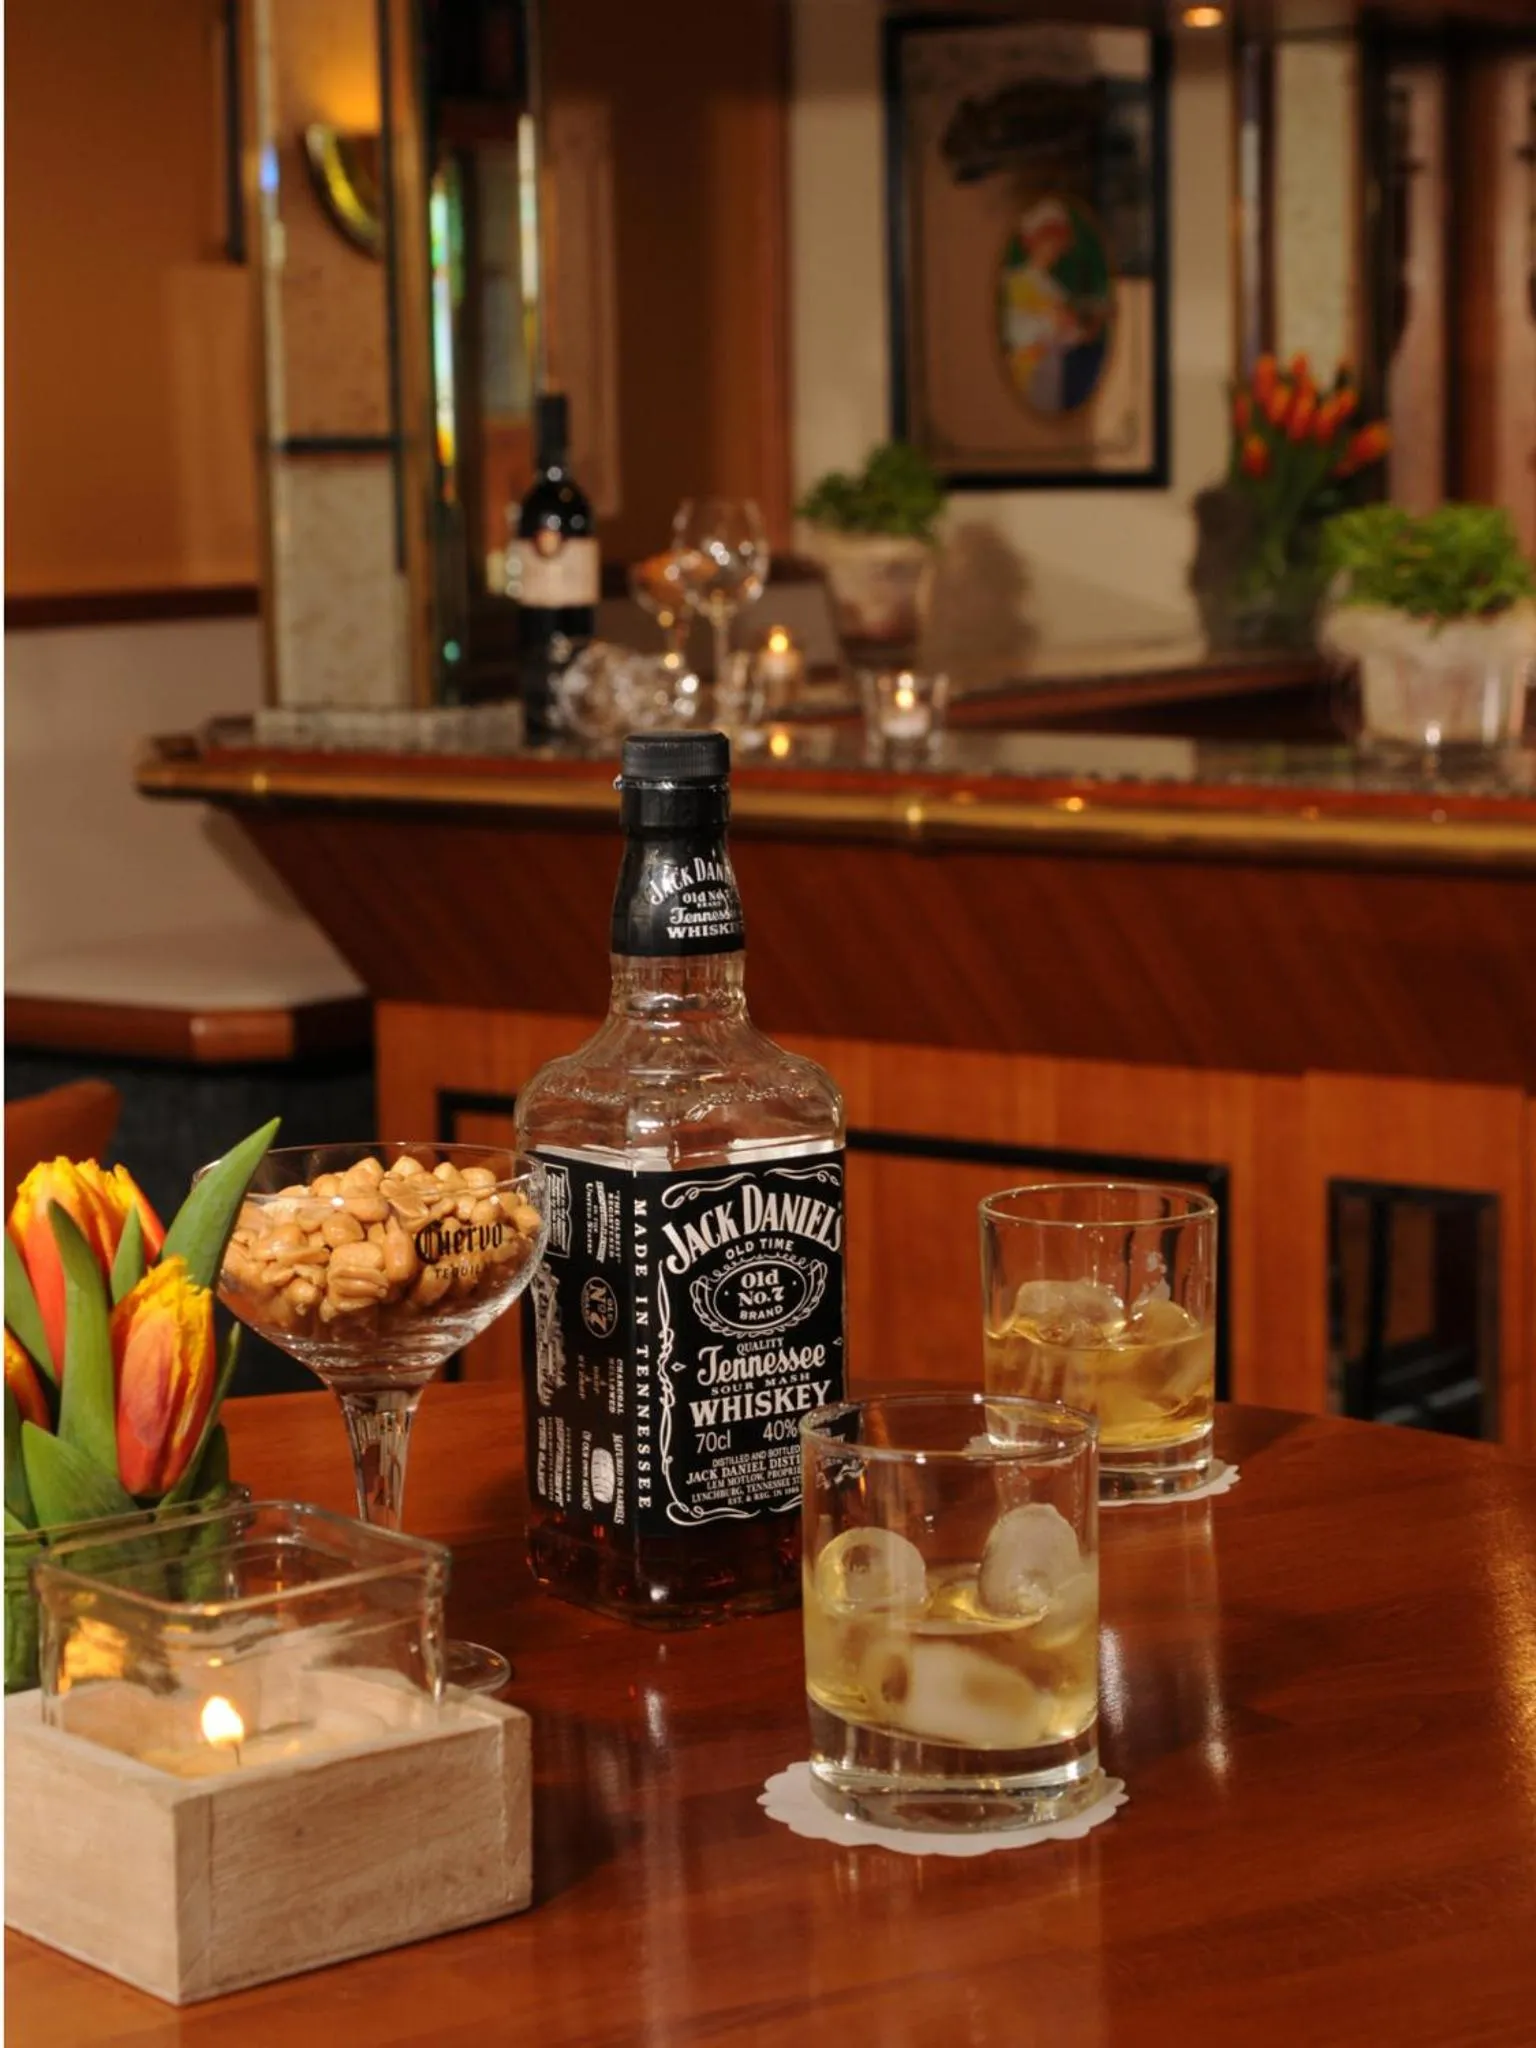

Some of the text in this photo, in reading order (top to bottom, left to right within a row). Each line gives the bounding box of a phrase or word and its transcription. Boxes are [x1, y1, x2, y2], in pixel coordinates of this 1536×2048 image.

[415, 1220, 502, 1264] Cuervo
[662, 1201, 741, 1274] JACK
[725, 1237, 794, 1260] OLD TIME
[738, 1268, 785, 1308] Old No.7
[740, 1305, 783, 1321] BRAND
[634, 1199, 652, 1508] MADE IN TENNESSEE
[736, 1337, 784, 1357] QUALITY
[697, 1344, 826, 1386] Tennessee
[711, 1372, 811, 1396] SOUR MASH
[689, 1380, 832, 1428] WHISKEY
[695, 1418, 798, 1453] 70cl 40%
[686, 1454, 801, 1485] JACK DANIEL DISTI
[712, 1452, 749, 1468] DISTILLED
